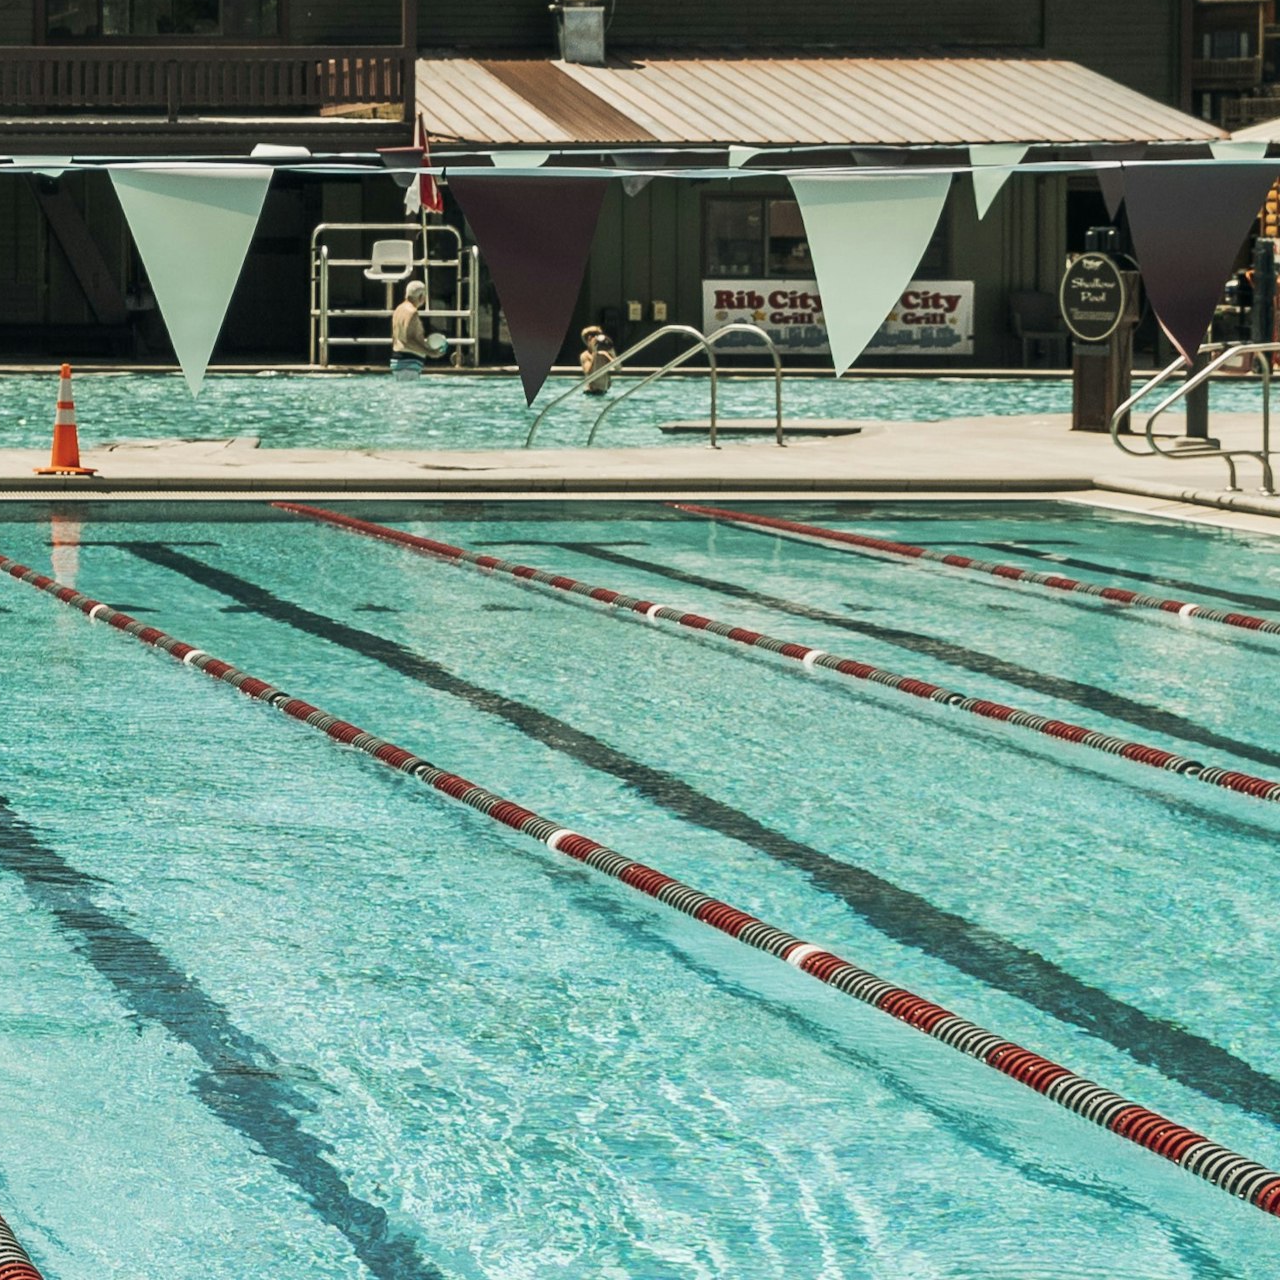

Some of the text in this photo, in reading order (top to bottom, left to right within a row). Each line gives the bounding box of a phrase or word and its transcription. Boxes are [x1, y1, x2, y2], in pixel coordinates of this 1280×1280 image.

[1071, 277, 1115, 289] Shallow
[714, 290, 823, 312] Rib City
[901, 291, 961, 313] City
[1080, 291, 1106, 302] Pool
[770, 312, 814, 324] Grill
[902, 313, 946, 325] Grill
